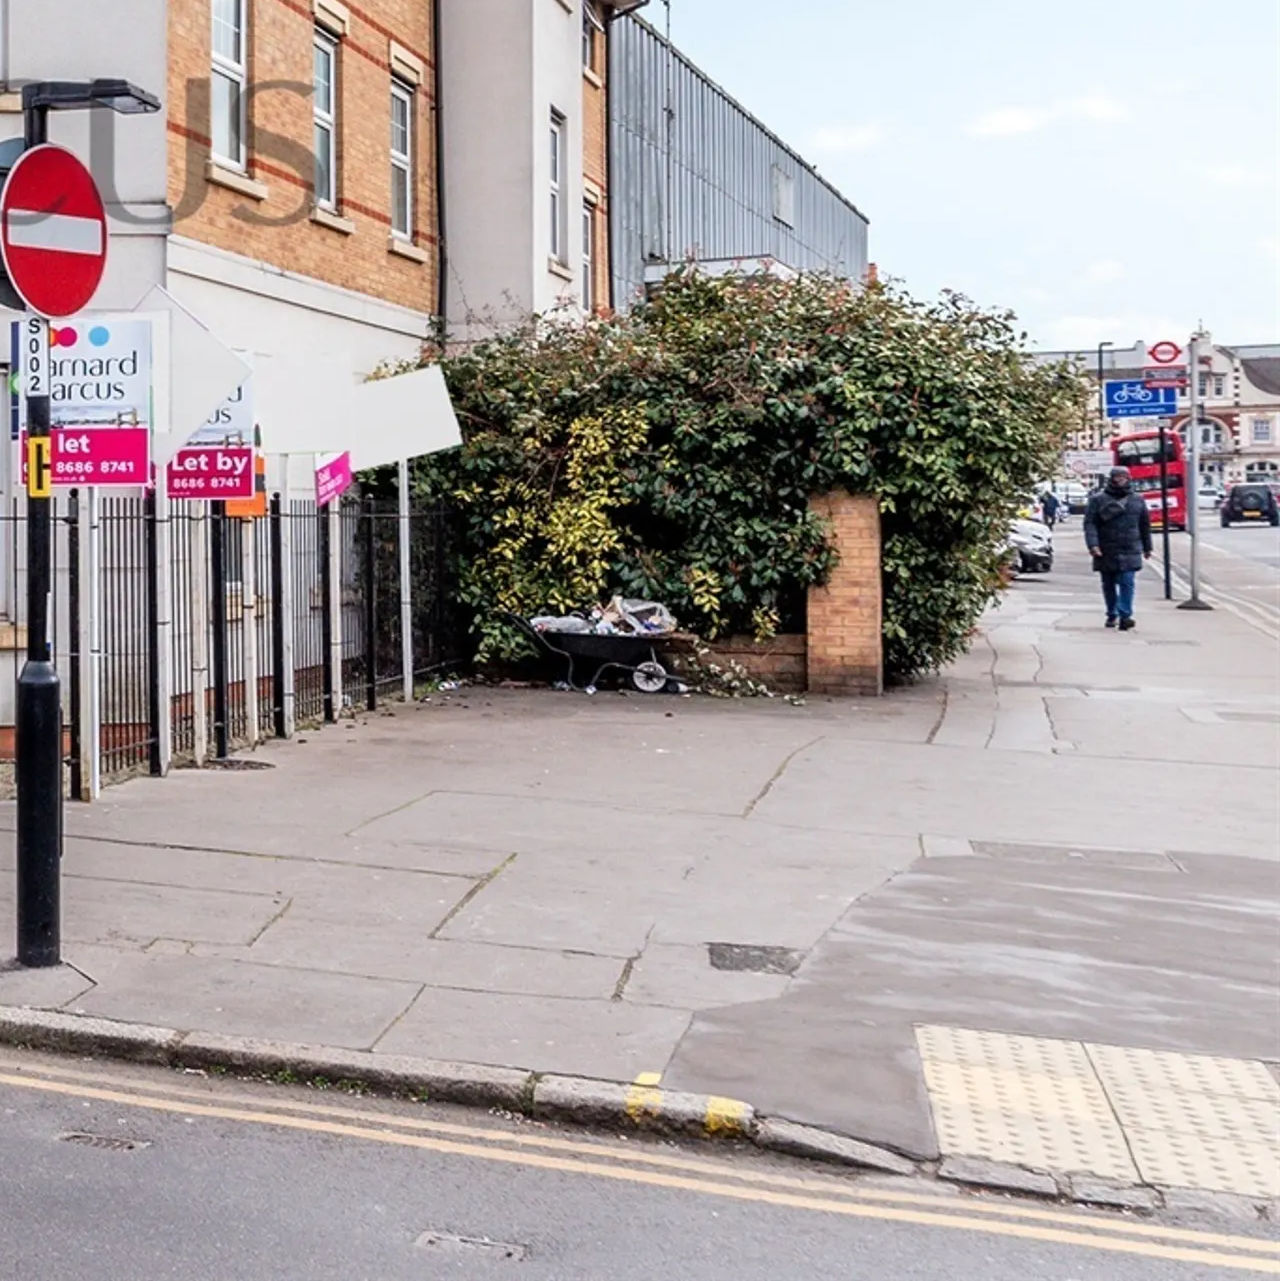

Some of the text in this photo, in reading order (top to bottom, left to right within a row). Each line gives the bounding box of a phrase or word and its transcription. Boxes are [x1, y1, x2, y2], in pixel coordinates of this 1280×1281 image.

[28, 318, 41, 392] S002
[51, 350, 137, 377] arnard
[52, 381, 125, 401] arcus
[58, 433, 90, 453] let
[55, 461, 134, 474] 8686 8741
[172, 452, 248, 474] Let by
[173, 477, 241, 489] 8686 8741
